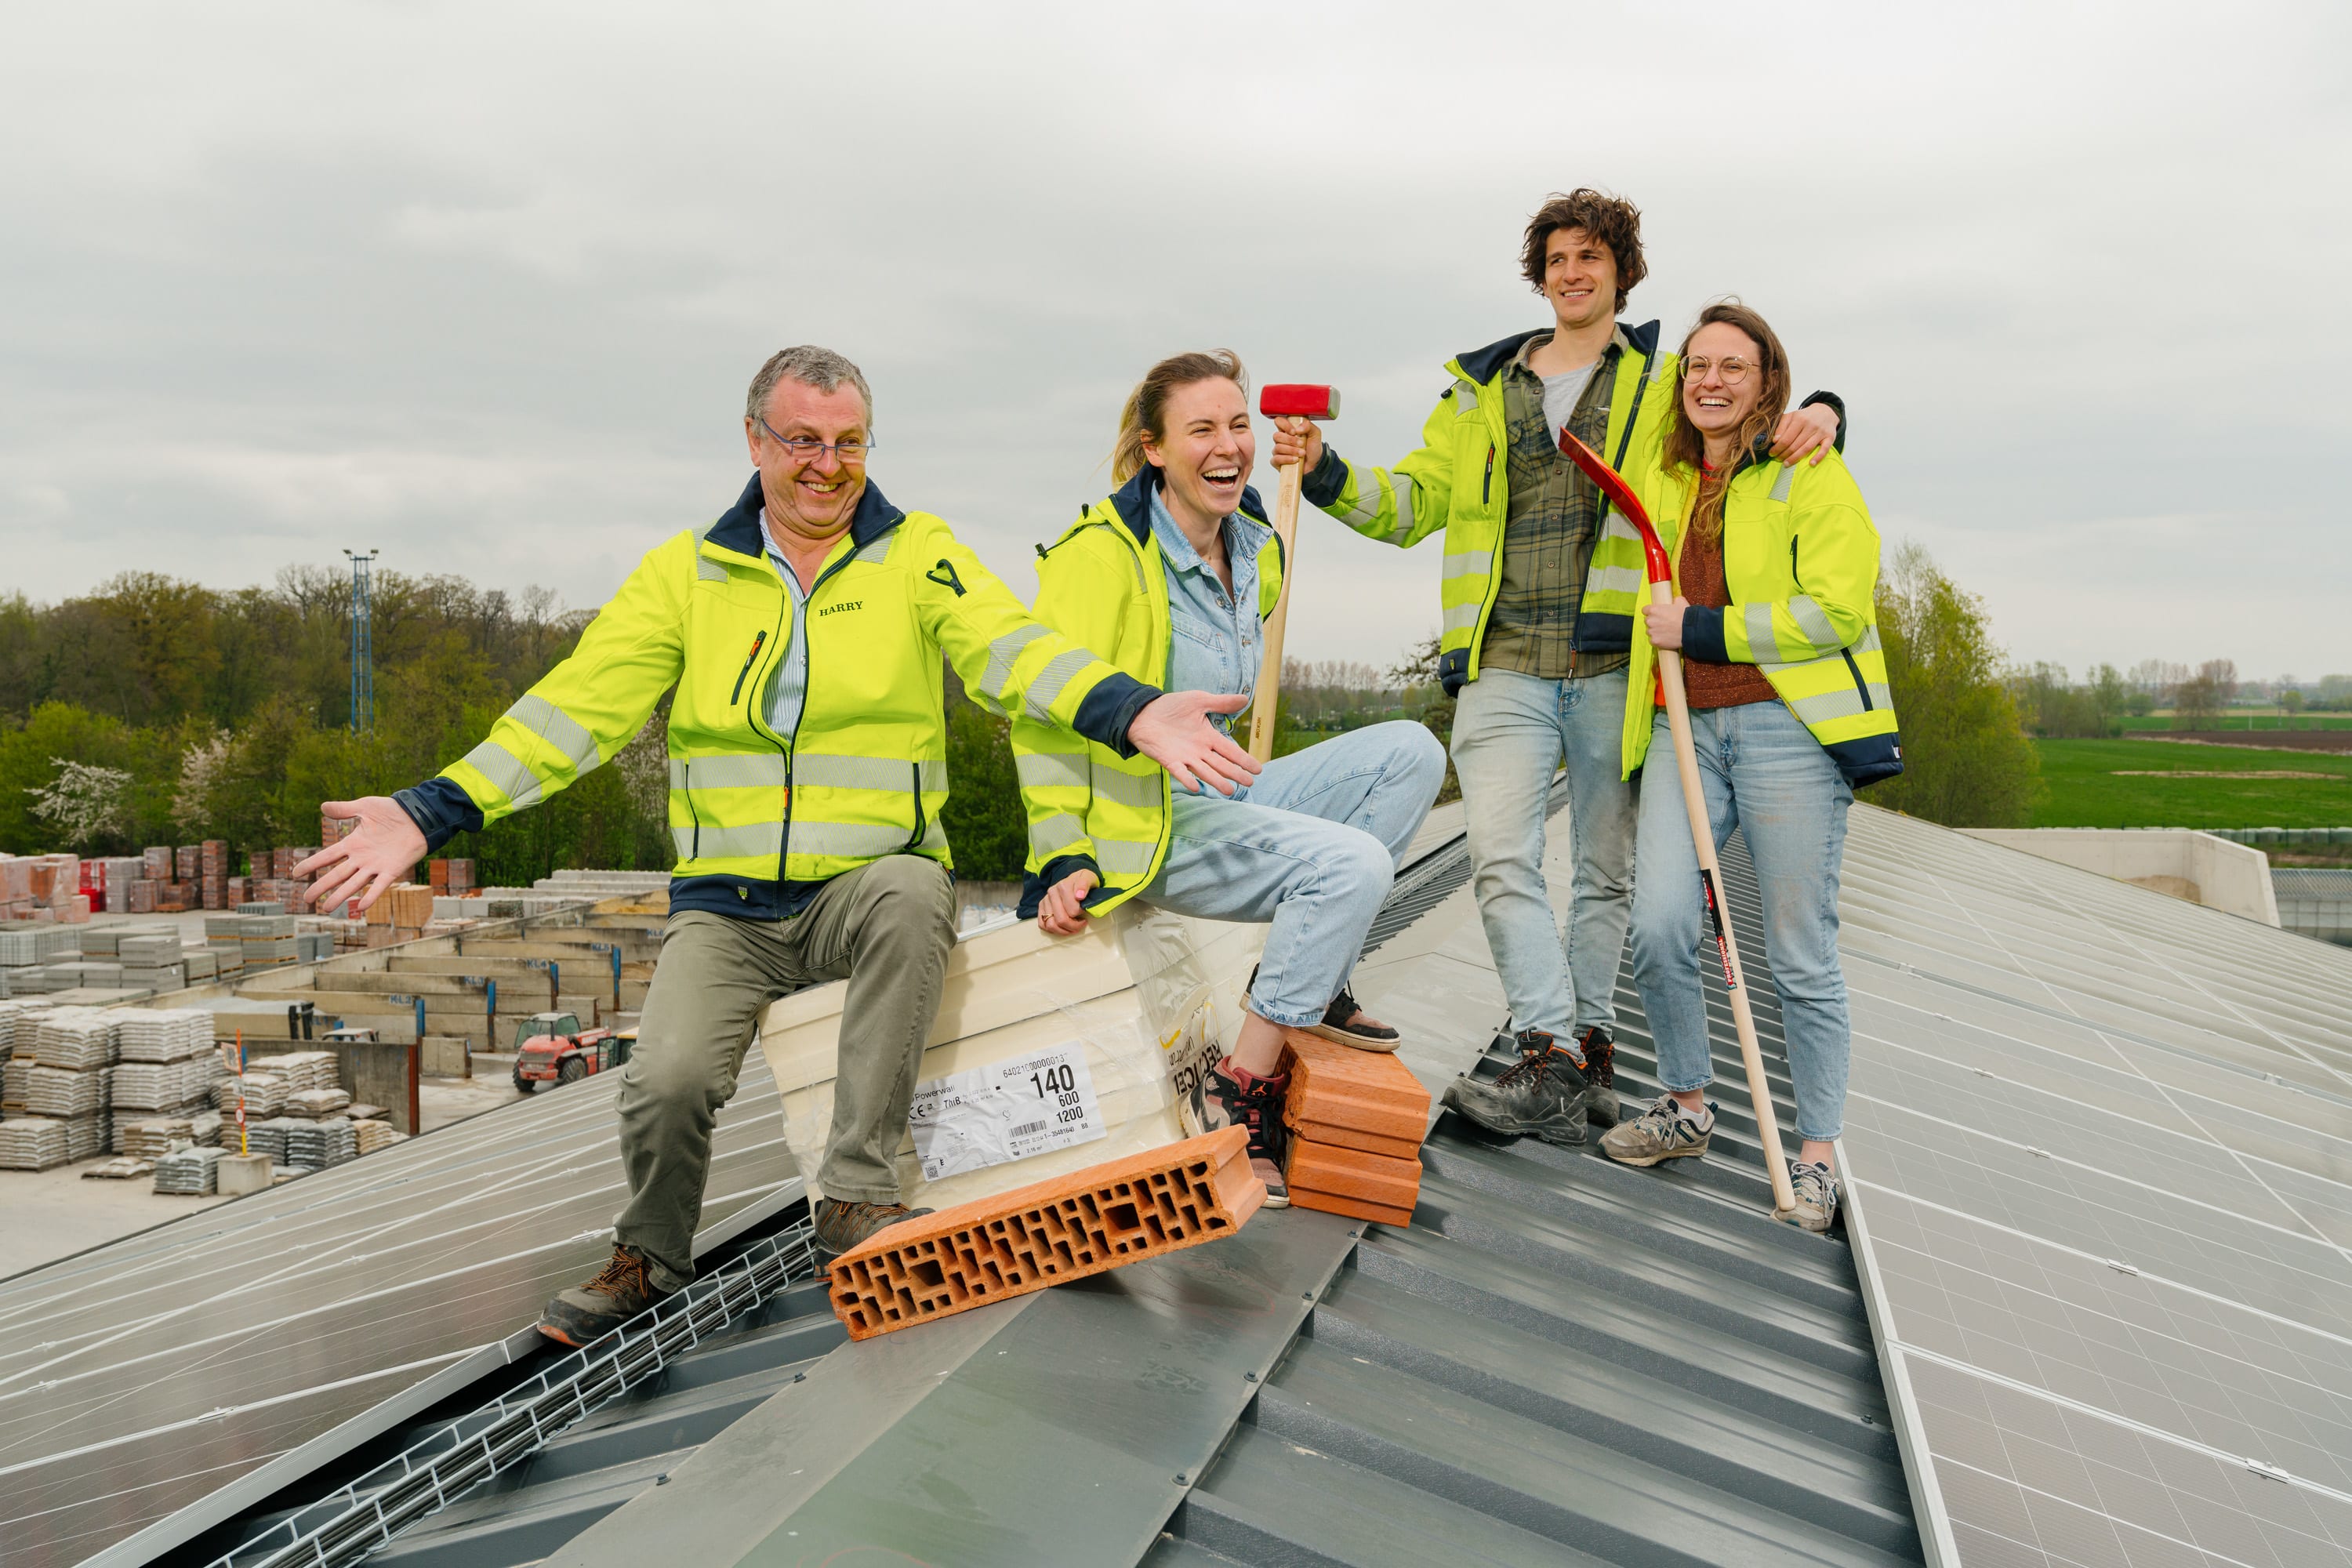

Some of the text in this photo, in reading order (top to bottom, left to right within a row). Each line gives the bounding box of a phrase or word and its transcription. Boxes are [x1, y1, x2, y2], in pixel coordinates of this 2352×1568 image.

[818, 601, 863, 617] HARRY
[527, 959, 547, 968] KL4
[1717, 938, 1734, 983] PROFESSIONAL
[390, 994, 412, 1004] KL2
[1030, 1064, 1075, 1098] 140
[914, 1085, 956, 1102] Powerwall
[1058, 1091, 1080, 1107] 600
[1056, 1105, 1083, 1123] 1200
